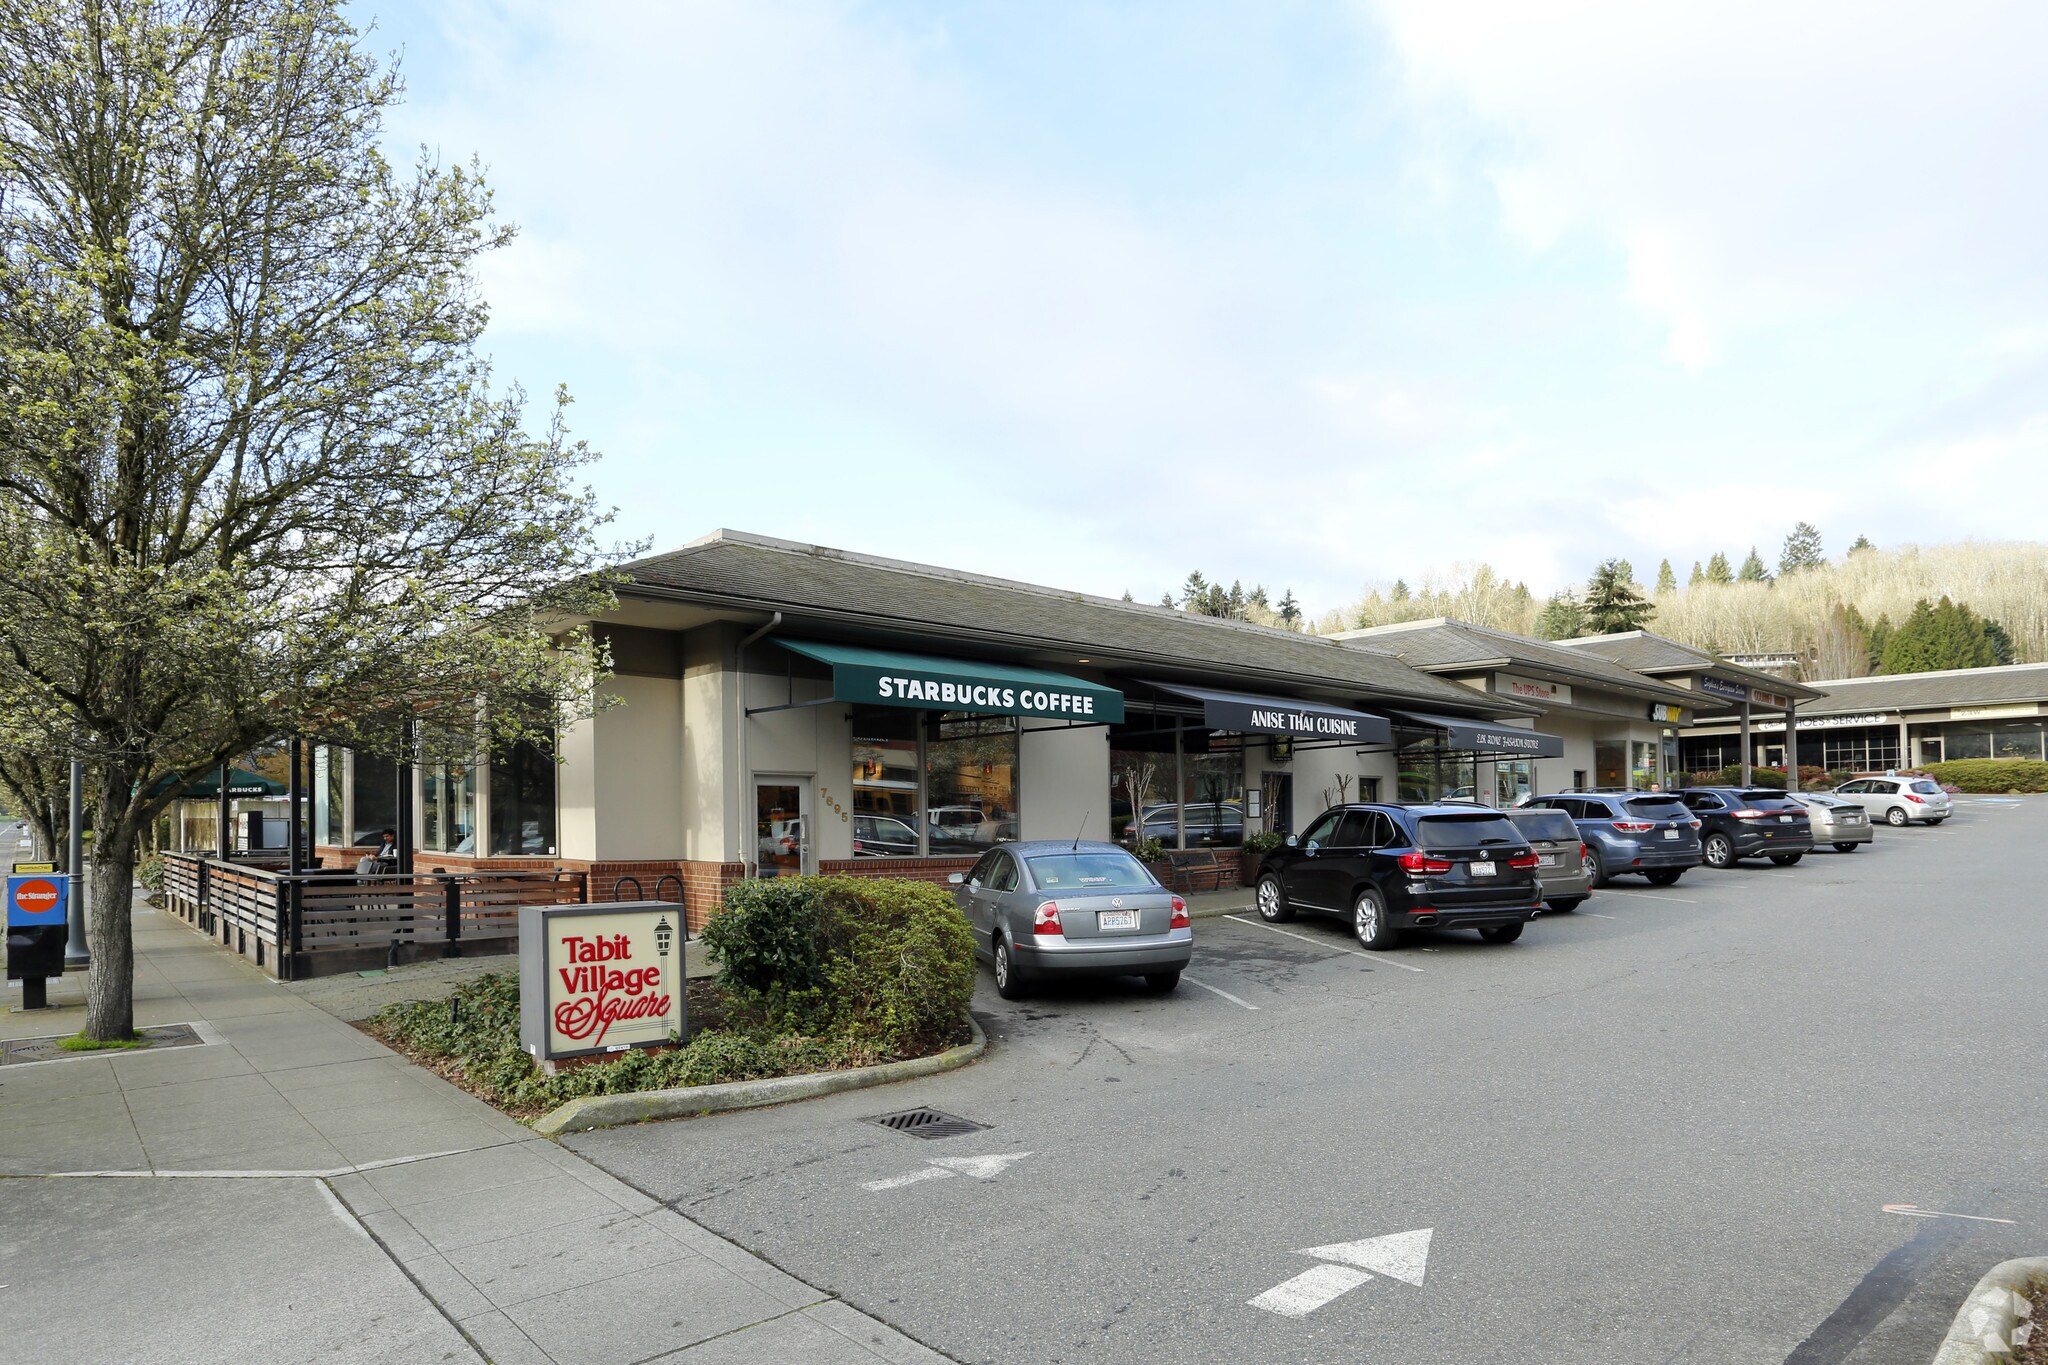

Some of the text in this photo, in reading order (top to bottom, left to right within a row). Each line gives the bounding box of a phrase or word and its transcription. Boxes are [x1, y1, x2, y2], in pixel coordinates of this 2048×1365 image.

[878, 676, 1094, 715] STARBUCKS COFFEE
[1511, 682, 1550, 699] The UPS Store
[1251, 710, 1358, 736] ANISE THAI CUISINE
[1652, 703, 1681, 723] SUBWAY
[1796, 716, 1826, 728] HOES
[1832, 713, 1880, 726] SERVICE
[216, 786, 262, 794] SRBUCKS
[820, 787, 849, 823] 7695
[561, 933, 633, 964] Tabit
[558, 965, 661, 996] Village
[554, 982, 671, 1048] Square
